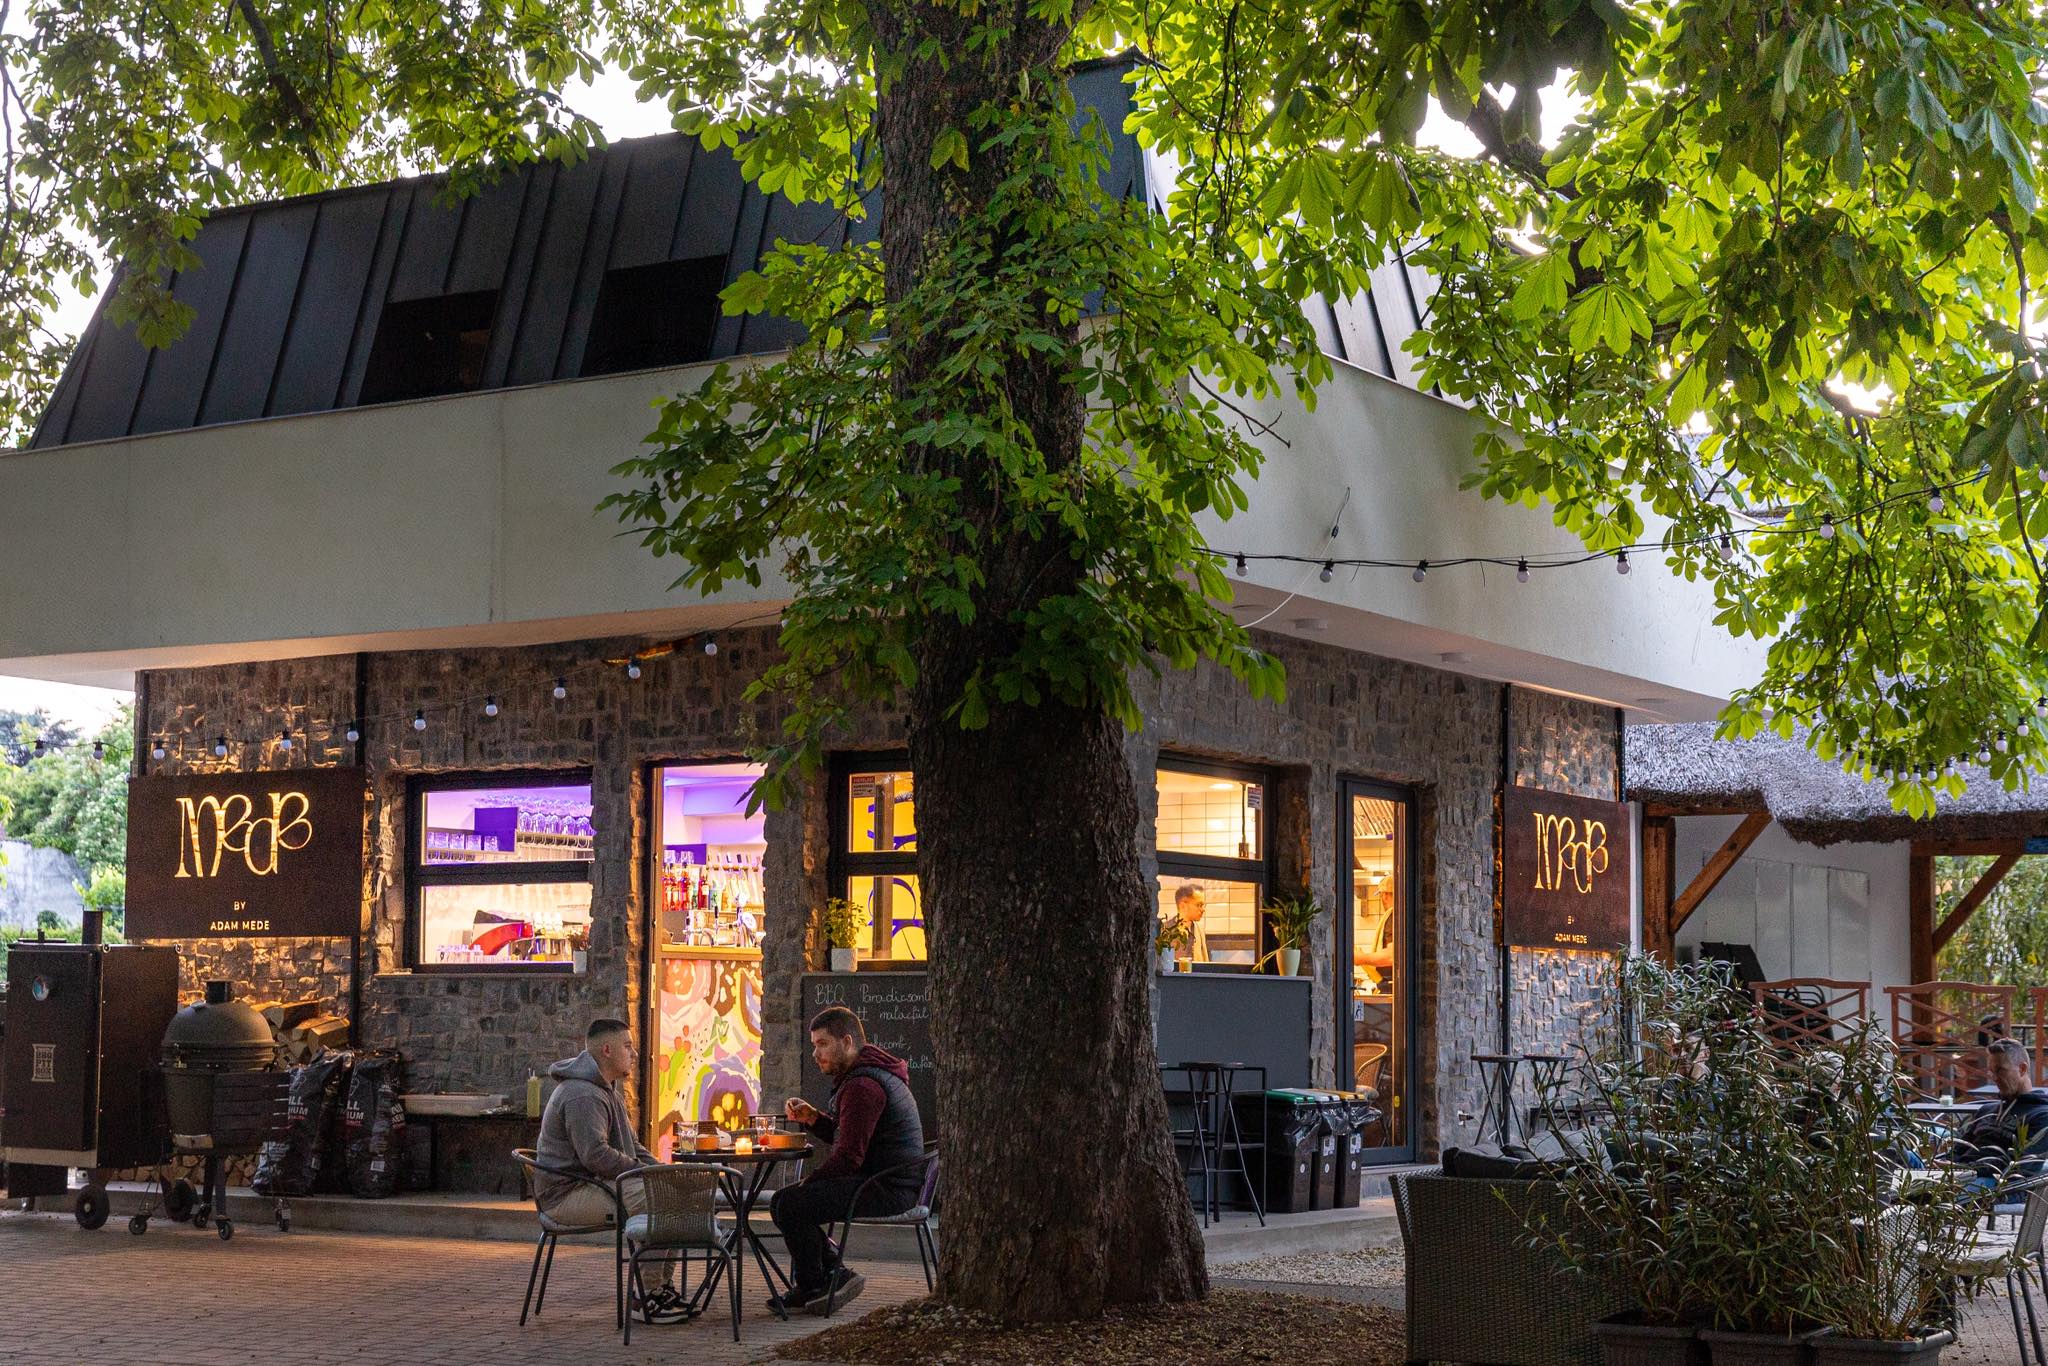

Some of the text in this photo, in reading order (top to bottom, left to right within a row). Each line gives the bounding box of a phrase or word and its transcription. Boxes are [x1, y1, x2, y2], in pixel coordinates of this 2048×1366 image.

[233, 901, 246, 911] BY
[210, 920, 270, 931] ADAM MEDE
[1554, 933, 1571, 943] ADAM
[288, 1096, 304, 1106] ILL
[346, 1100, 360, 1111] LL
